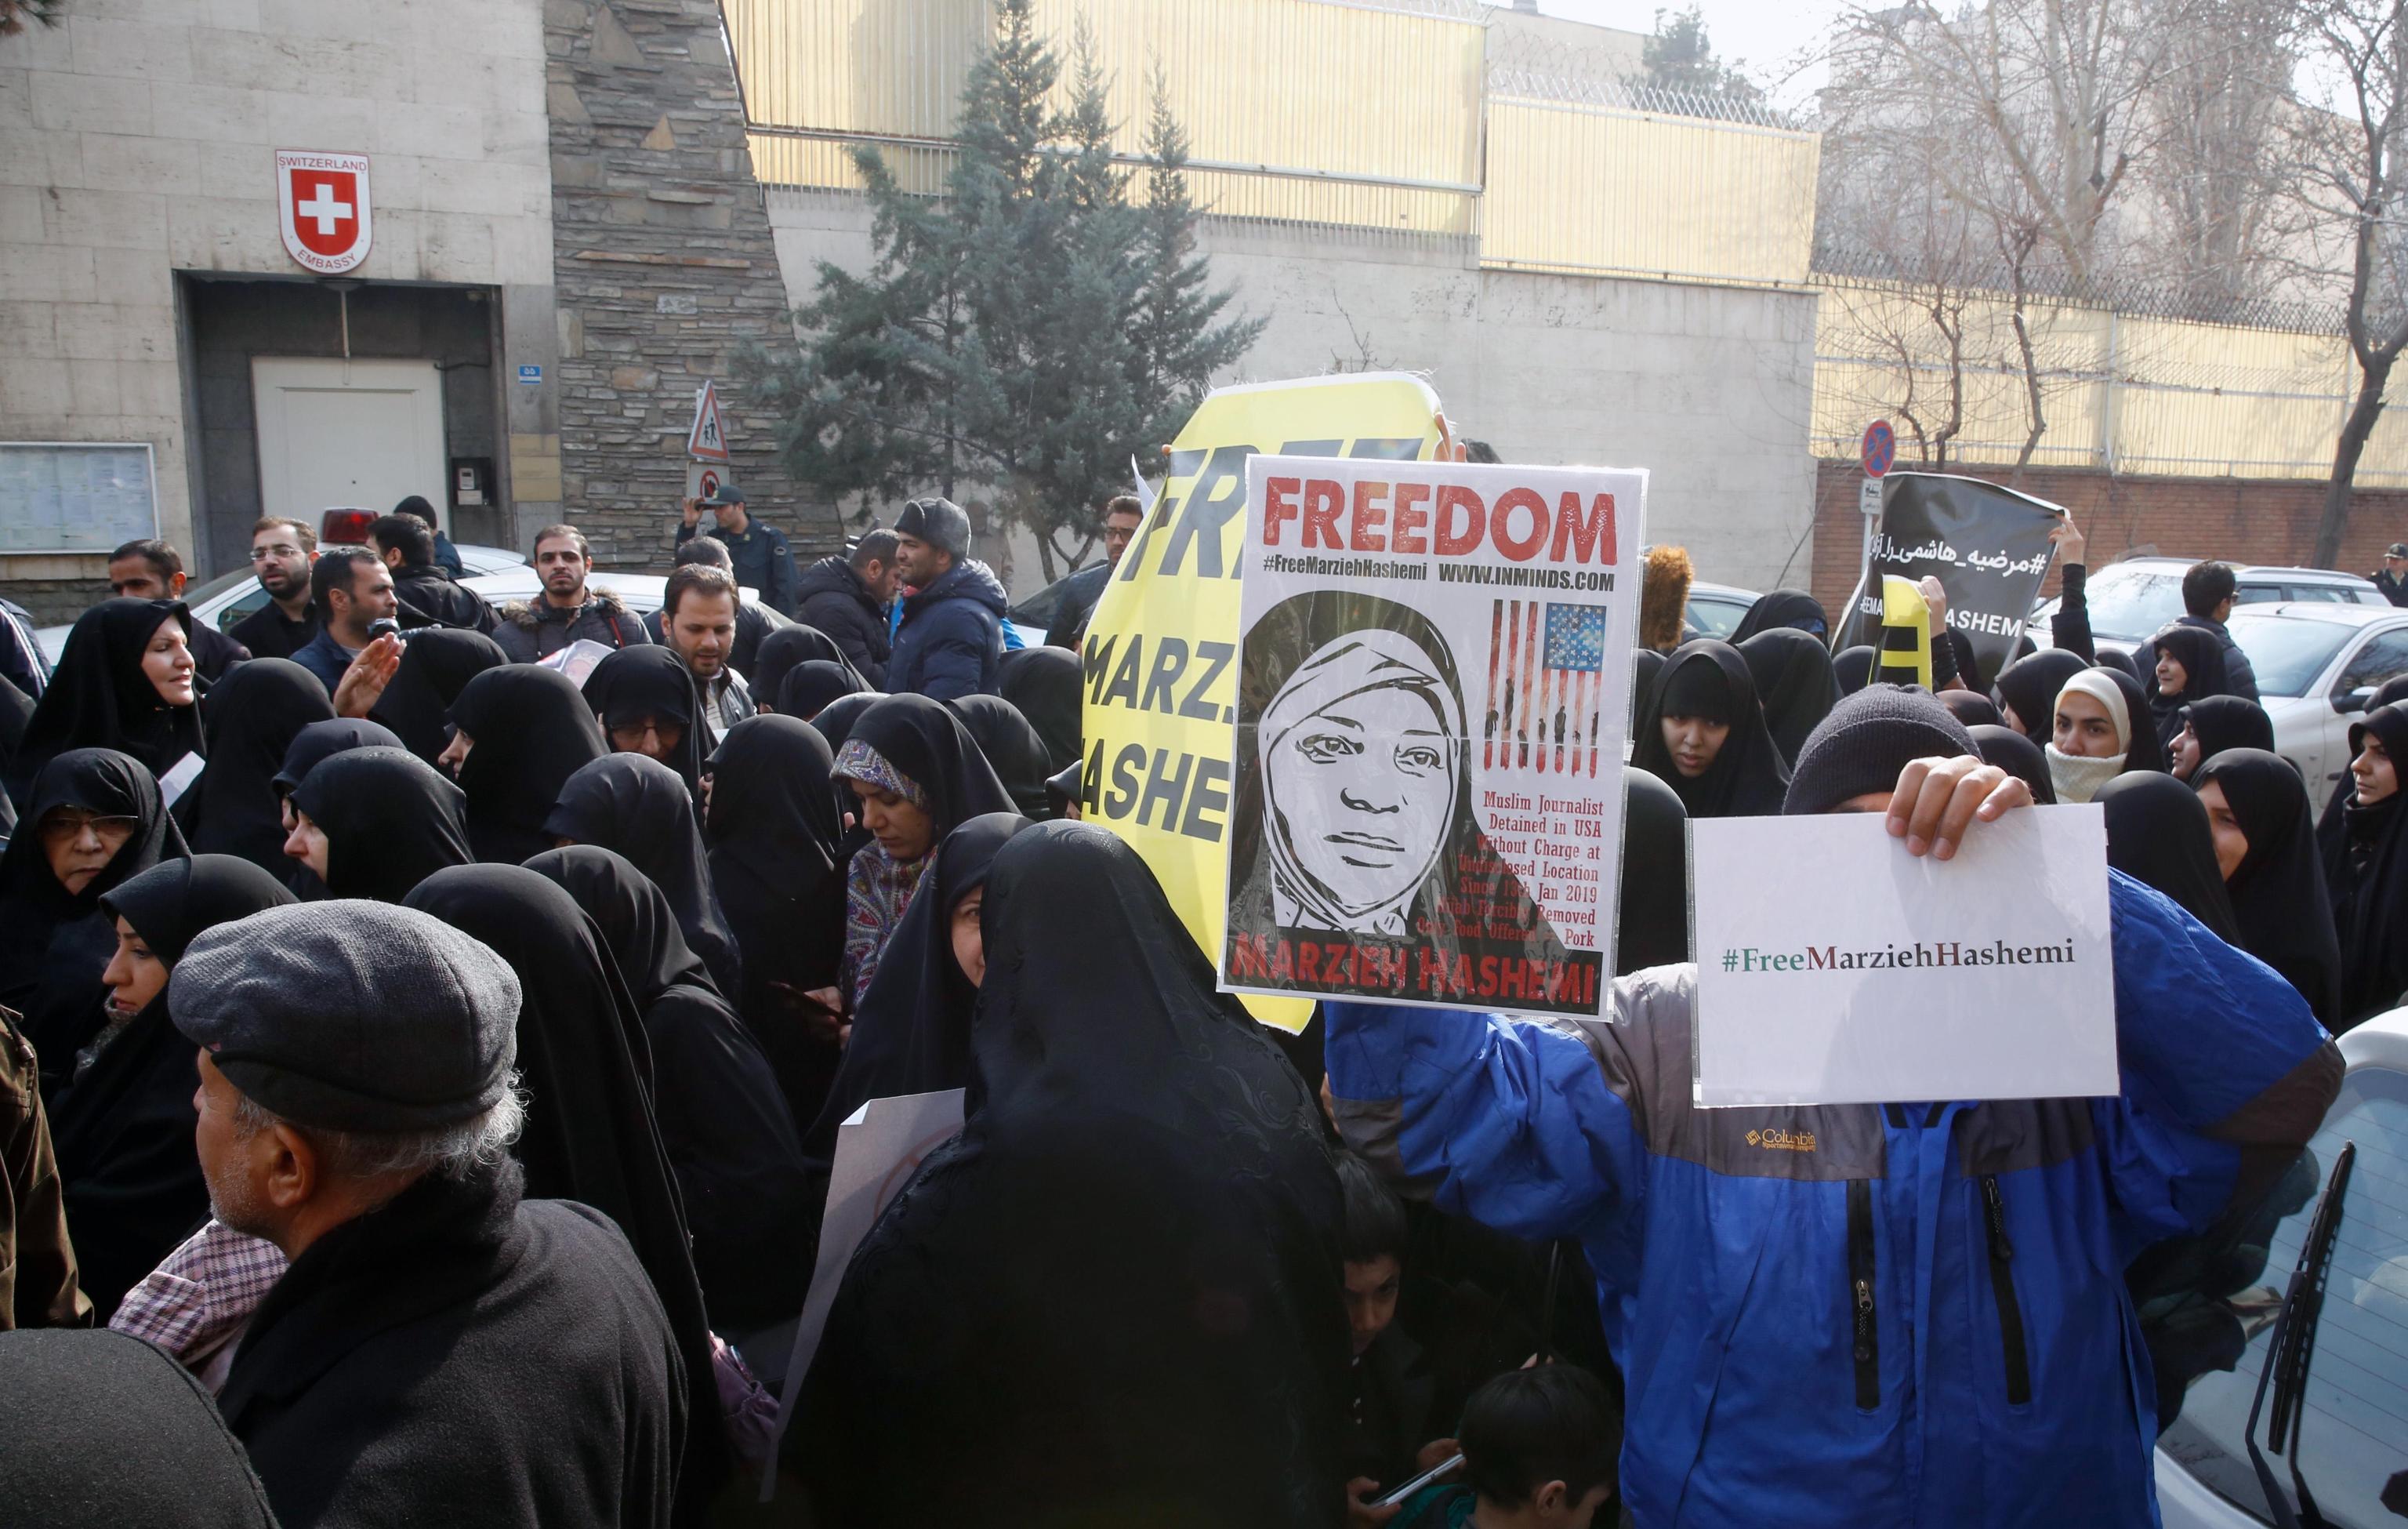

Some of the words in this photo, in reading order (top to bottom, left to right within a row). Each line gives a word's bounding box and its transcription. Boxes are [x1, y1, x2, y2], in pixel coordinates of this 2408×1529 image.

[278, 156, 367, 171] SWITZERLAND
[297, 249, 357, 269] EMBASSY
[1263, 476, 1618, 566] FREEDOM
[1263, 554, 1427, 581] #FreeMarziehHashemi
[1439, 563, 1615, 592] WWW.INMINDS.COM
[1083, 634, 1235, 725] MARZ
[1082, 738, 1230, 843] ASHE
[1483, 790, 1531, 811] Muslim
[1538, 794, 1603, 815] Journalist
[1489, 813, 1546, 834] Detained
[1554, 818, 1566, 835] in
[1575, 821, 1601, 838] USA
[1476, 834, 1527, 855] Without
[1534, 838, 1579, 861] Charge
[1587, 847, 1600, 860] at
[1543, 861, 1598, 882] Location
[1460, 876, 1496, 896] Since
[1537, 883, 1558, 902] Jan
[1566, 885, 1597, 903] 2019
[1478, 899, 1530, 924] Forciby
[1536, 905, 1595, 925] Removed
[1417, 917, 1446, 939] Ony
[1564, 929, 1595, 947] Pork
[1231, 930, 1406, 990] MARZIEH
[1417, 946, 1594, 1004] HASHEMI
[1721, 937, 2076, 972] #FreeMarziehHashemi
